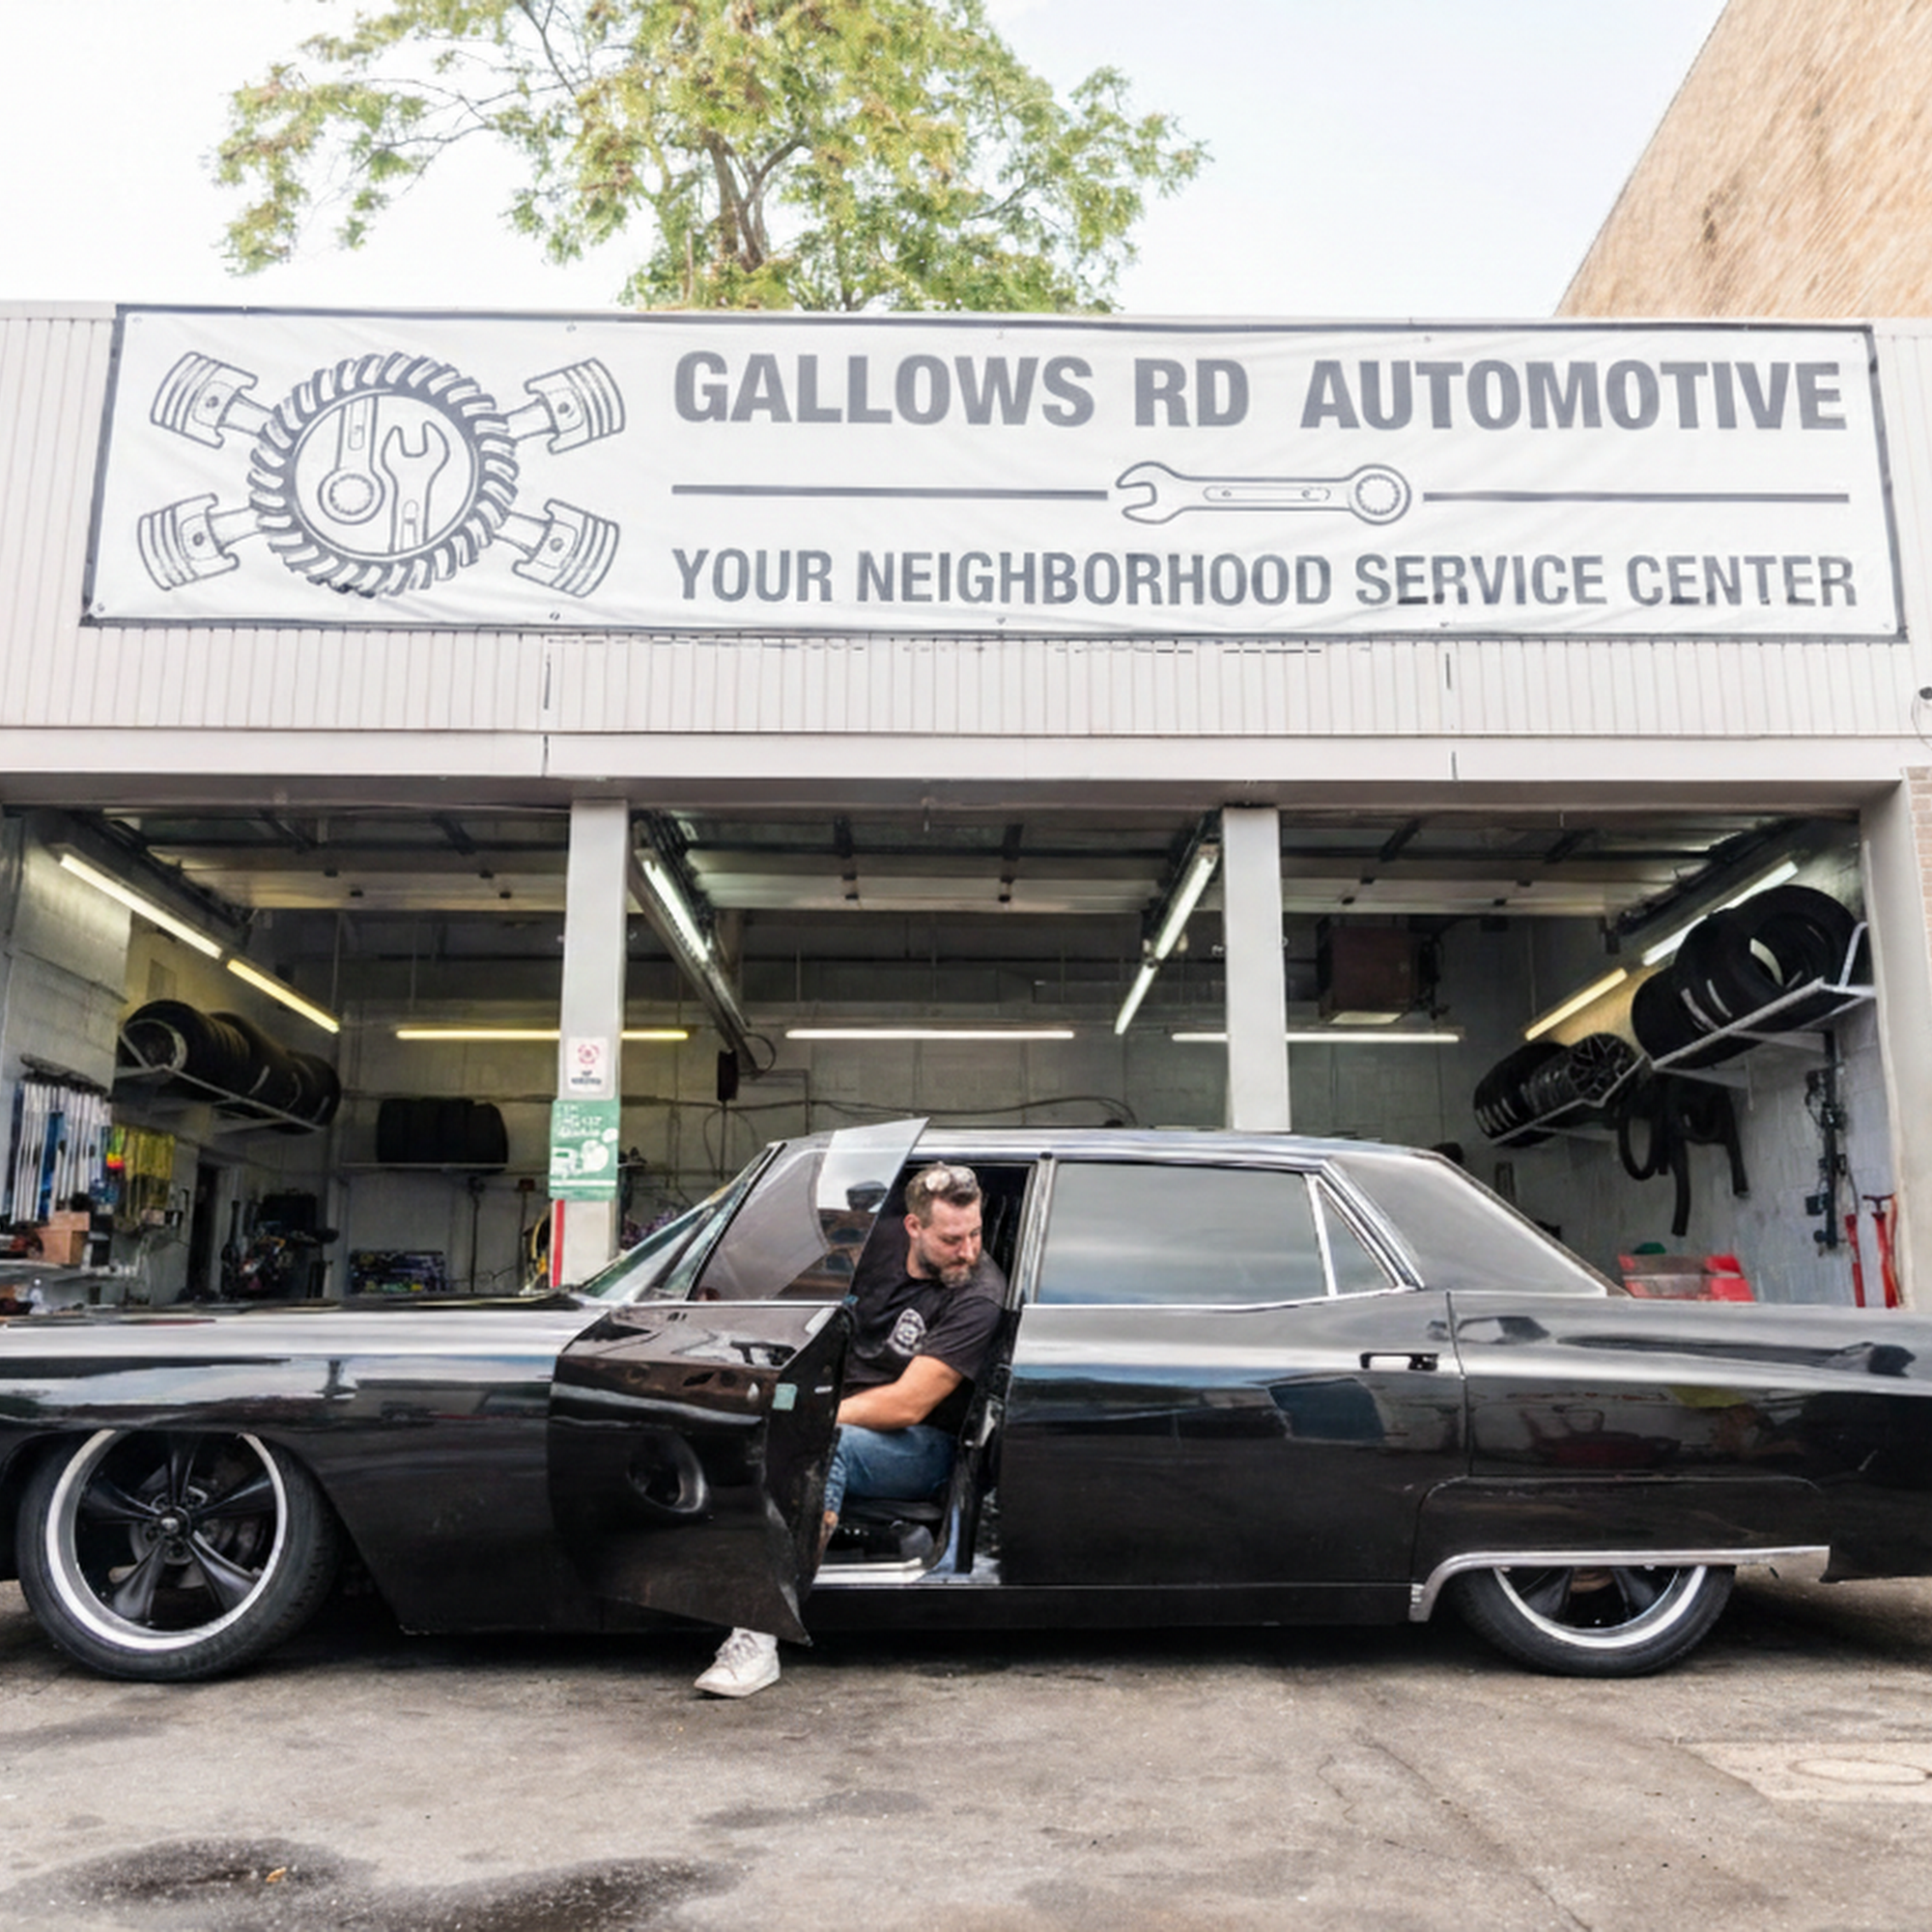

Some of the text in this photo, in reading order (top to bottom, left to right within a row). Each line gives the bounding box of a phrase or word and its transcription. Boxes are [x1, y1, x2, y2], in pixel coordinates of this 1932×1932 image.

[675, 352, 1846, 430] GALLOWS RD AUTOMOTIVE
[672, 549, 1856, 607] YOUR NEIGHBORHOOD SERVICE CENTER
